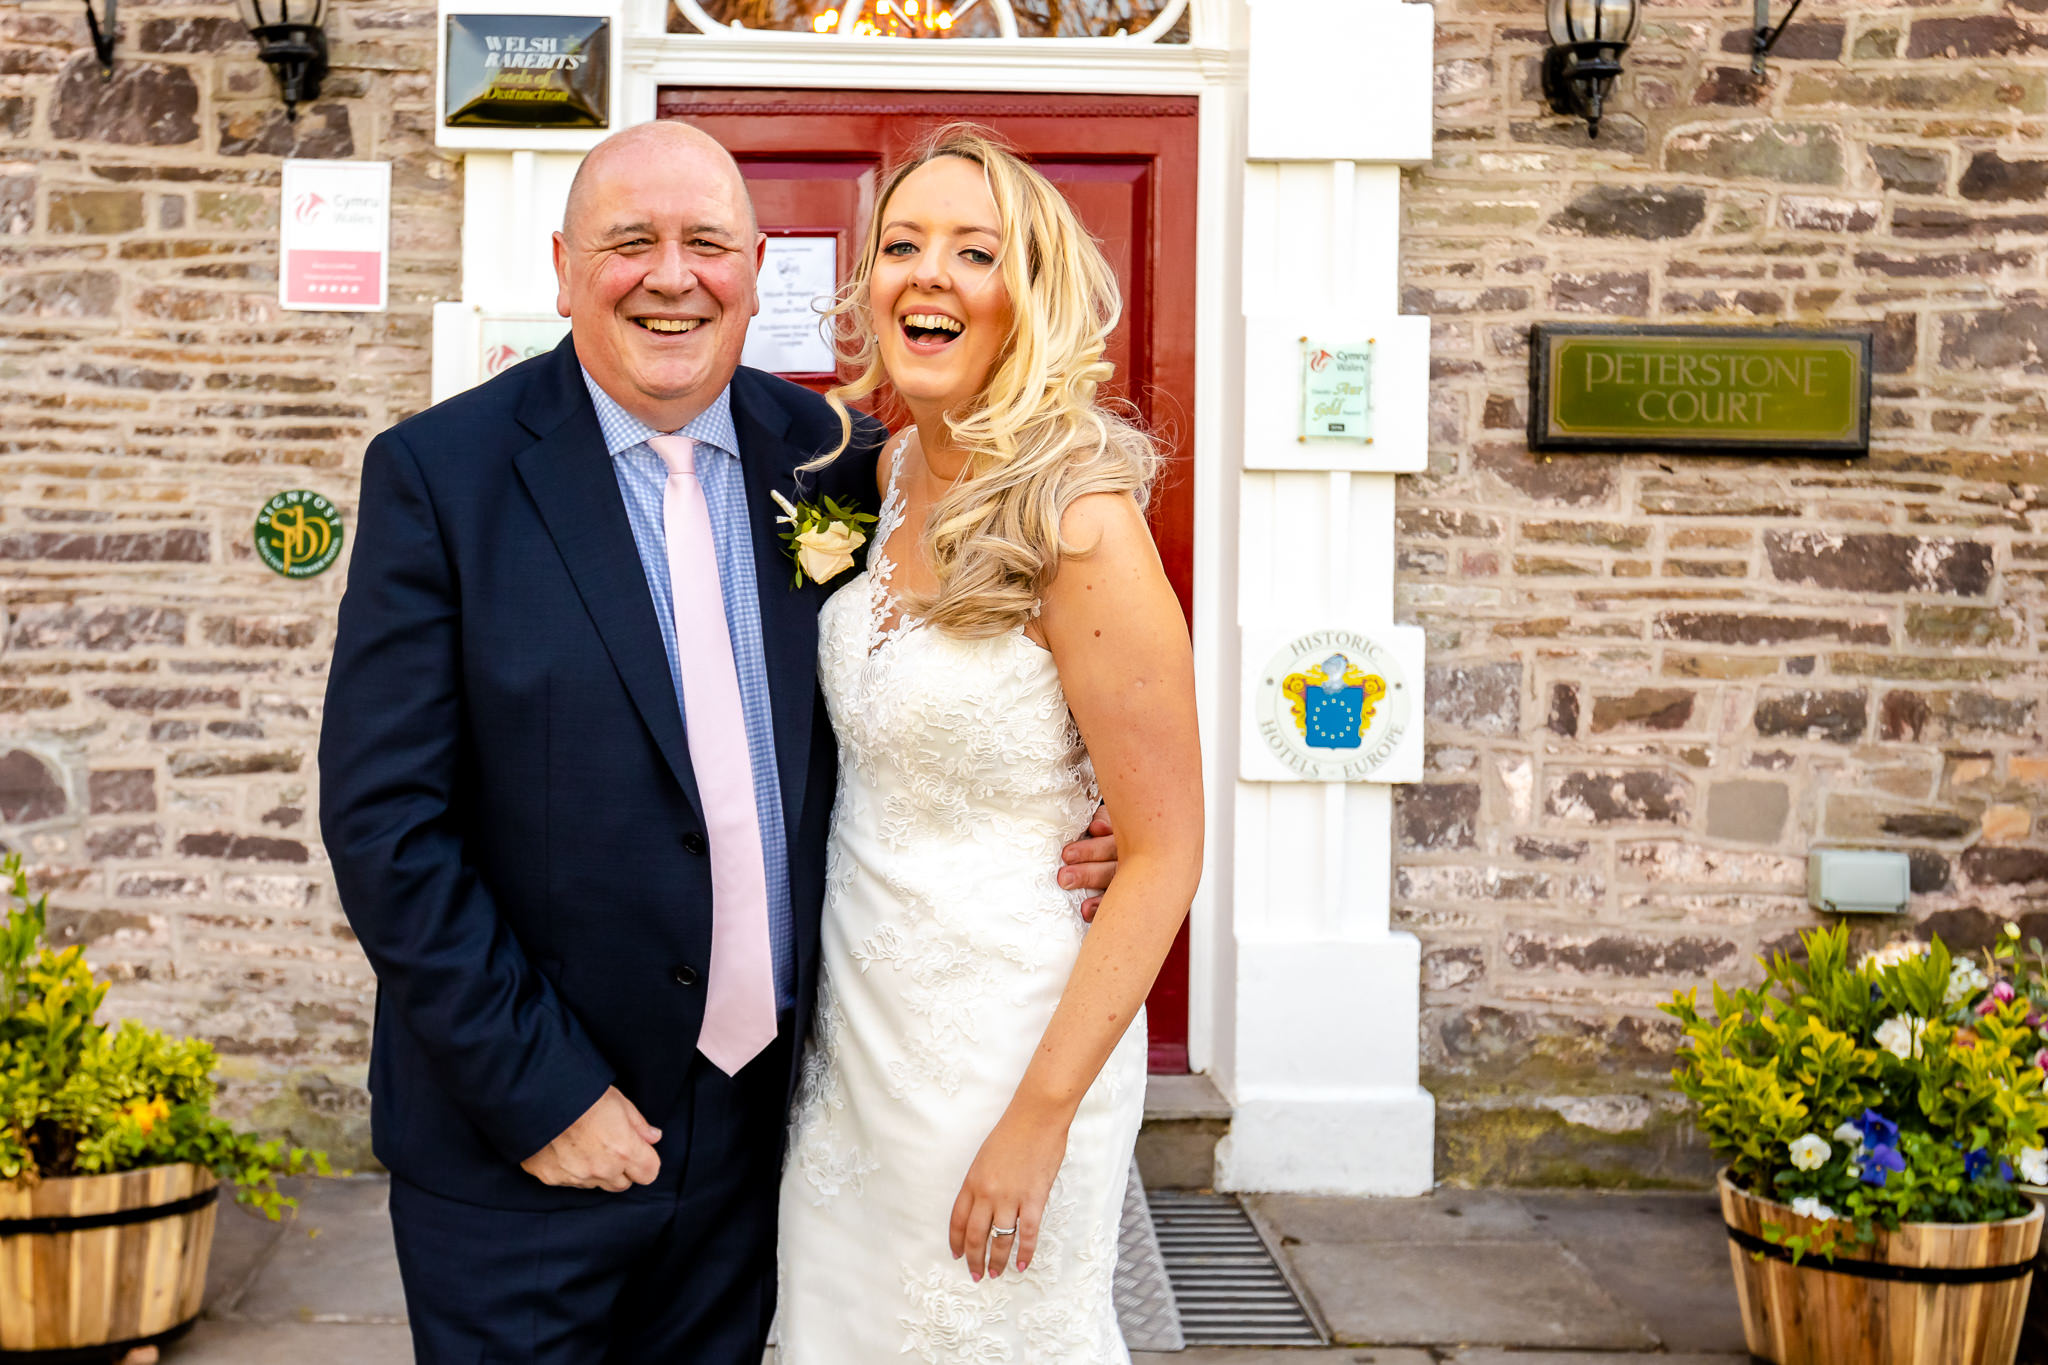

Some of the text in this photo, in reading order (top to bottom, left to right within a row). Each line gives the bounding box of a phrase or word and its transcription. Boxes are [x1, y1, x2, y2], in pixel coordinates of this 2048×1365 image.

[485, 36, 557, 52] WELSH
[487, 69, 533, 84] otels
[484, 88, 569, 101] Distinction
[334, 194, 380, 210] Cymru
[1336, 351, 1369, 361] Cymru
[1337, 363, 1365, 372] Wales
[1585, 352, 1828, 397] PETERSTONE
[1638, 390, 1772, 424] COURT
[258, 491, 341, 526] SIGNPOST
[1290, 631, 1384, 661] HISTORIC
[1262, 719, 1405, 779] HOTELS EUROPE
